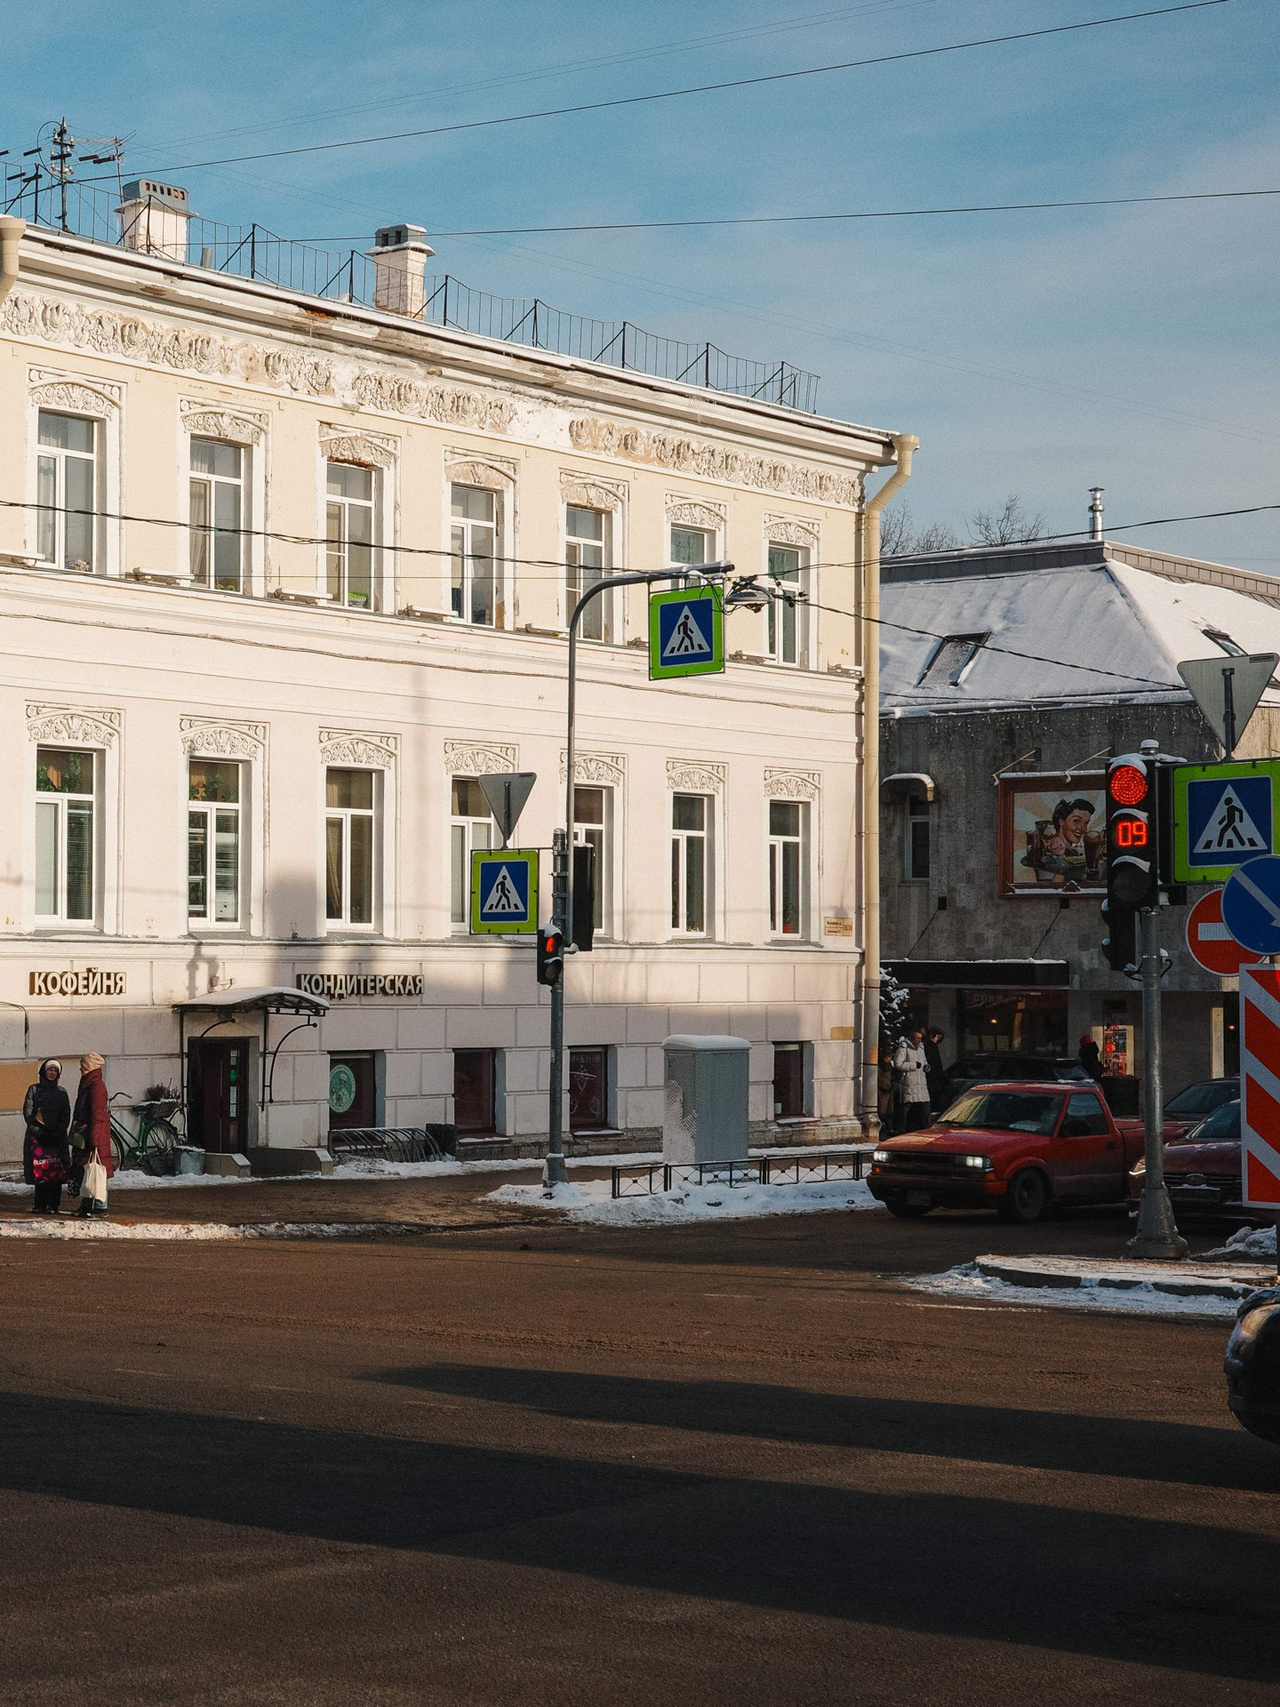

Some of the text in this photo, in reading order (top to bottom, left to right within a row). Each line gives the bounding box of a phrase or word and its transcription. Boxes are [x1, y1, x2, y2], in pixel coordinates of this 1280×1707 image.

[1118, 821, 1147, 846] 09
[33, 967, 425, 998] КОФЕЙНЯ КОНДИТЕРСКАЯ
